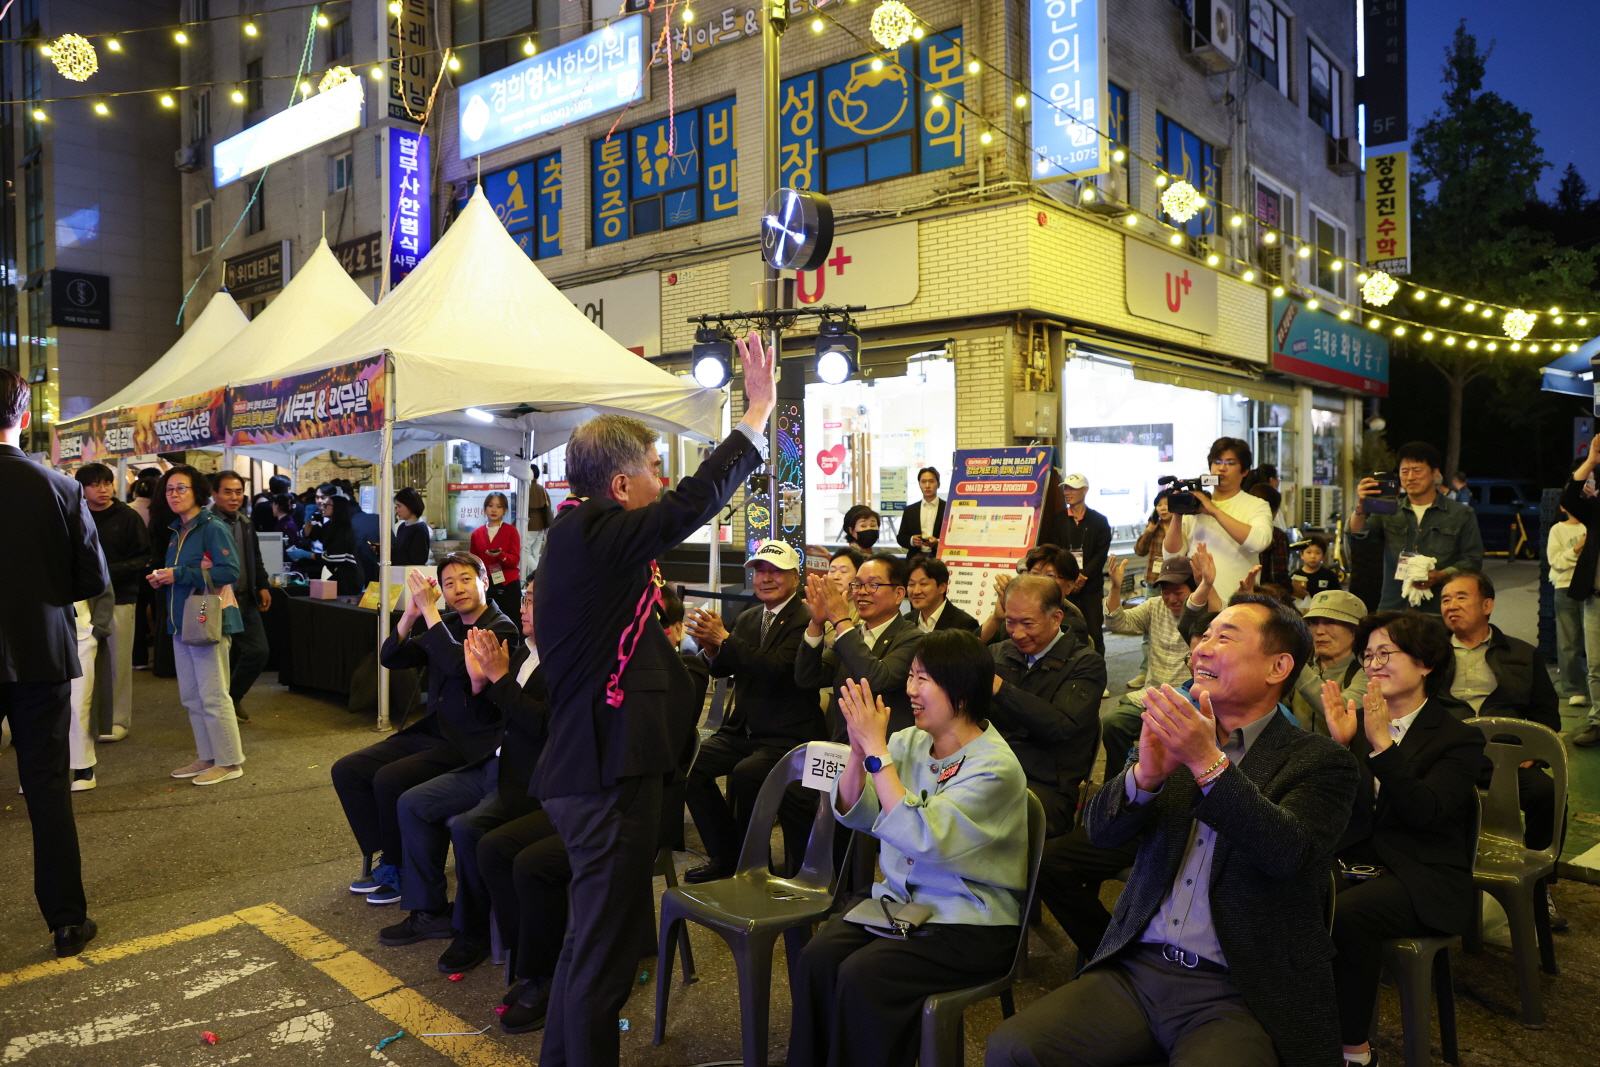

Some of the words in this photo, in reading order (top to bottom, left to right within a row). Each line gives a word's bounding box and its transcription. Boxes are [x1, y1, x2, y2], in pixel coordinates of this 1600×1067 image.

[490, 31, 625, 113] 경희영신한의원
[1046, 0, 1081, 127] 한의원
[924, 38, 965, 158] 보약
[1374, 116, 1397, 134] 5F
[781, 80, 819, 190] 성장
[398, 136, 421, 195] 법무사
[599, 139, 626, 238] 통증
[1375, 155, 1397, 217] 장호진
[399, 196, 421, 255] 한범식
[1376, 218, 1398, 257] 수학
[393, 253, 424, 269] 사무
[1165, 269, 1192, 313] U+
[283, 390, 317, 424] 사무국
[316, 388, 328, 419] &
[328, 378, 369, 416] 의무실
[863, 367, 873, 377] U+
